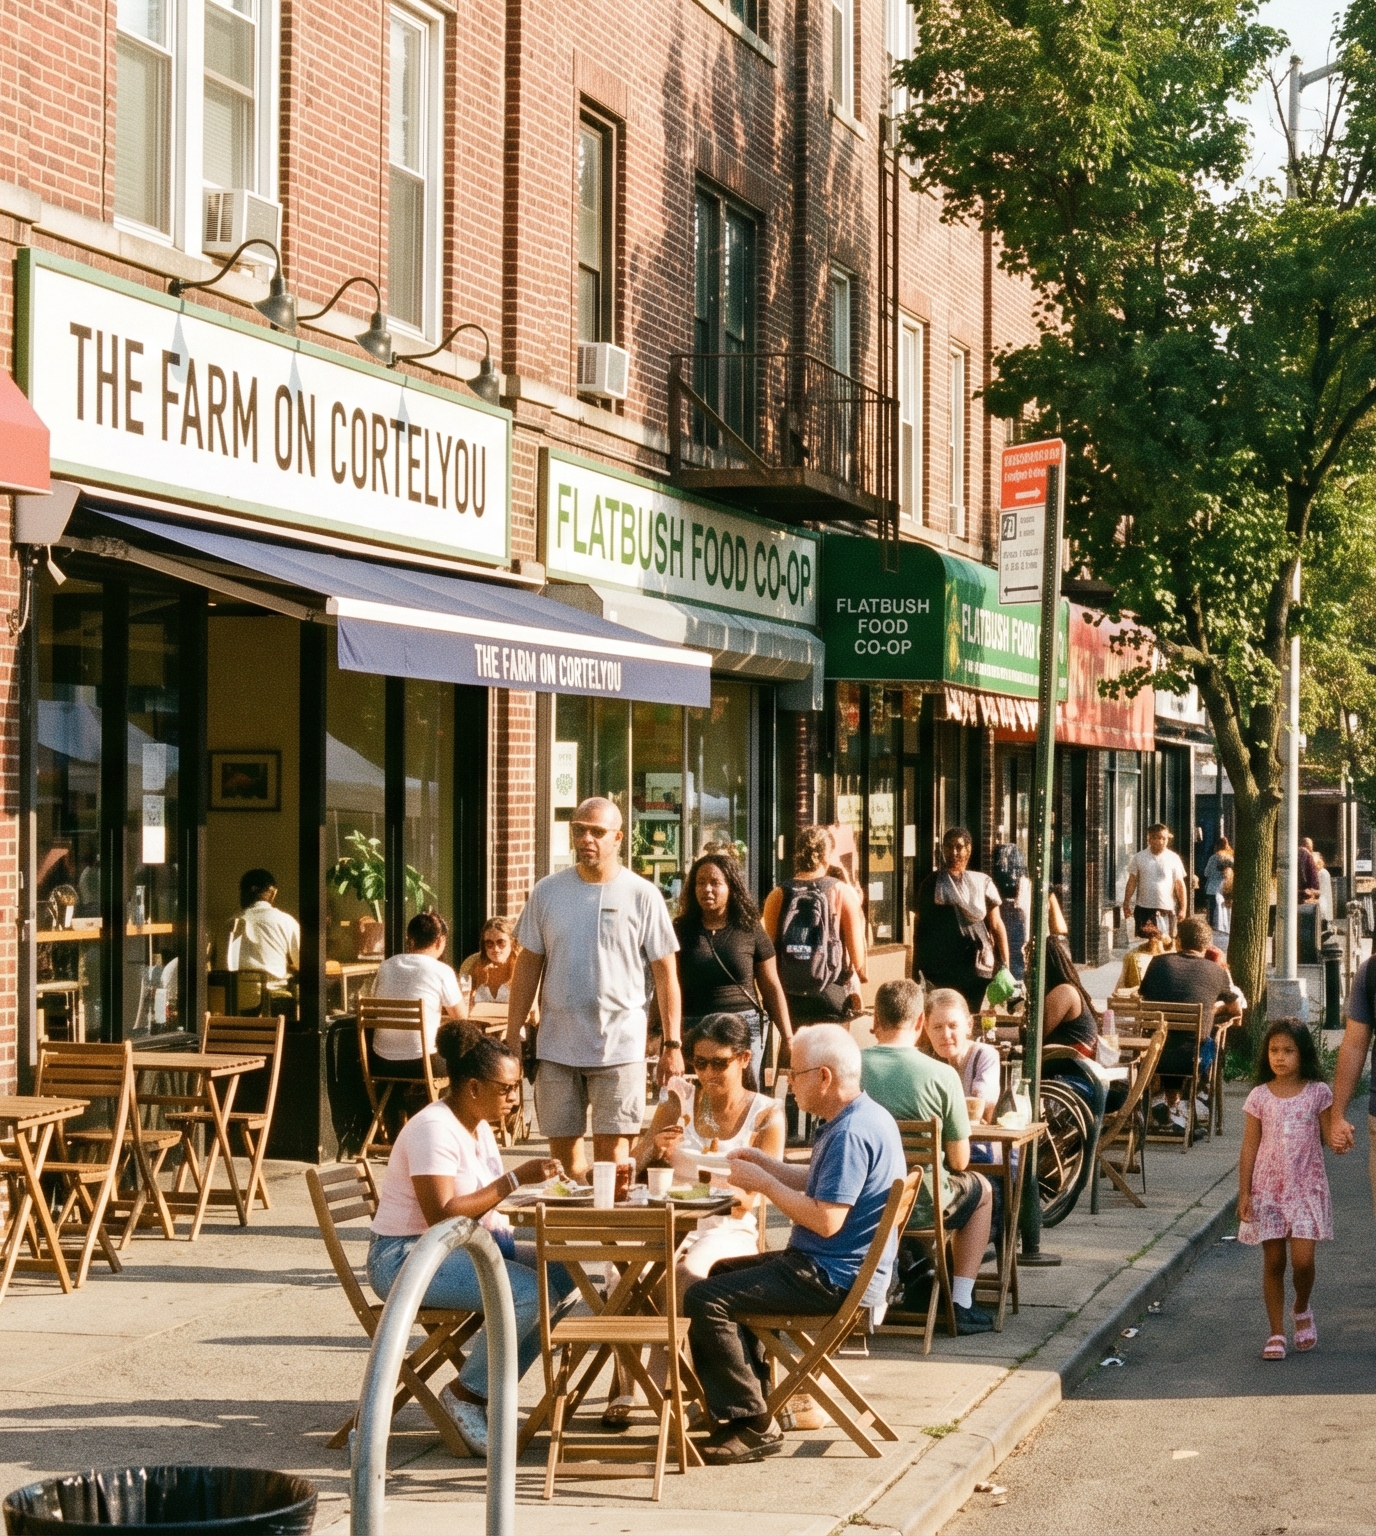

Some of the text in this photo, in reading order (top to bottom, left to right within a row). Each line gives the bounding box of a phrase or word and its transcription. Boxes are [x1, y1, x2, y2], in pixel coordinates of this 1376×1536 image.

[69, 321, 488, 519] THE FARM ON CORTELYOU
[557, 482, 812, 607] FLATBUSH FOOD CO-OP
[836, 598, 930, 615] FLATBUSH
[857, 619, 909, 634] FOOD
[961, 603, 1010, 653] FLATBUSH
[474, 643, 622, 692] THE FARM ON CORTELYOU
[854, 639, 912, 655] CO-OP
